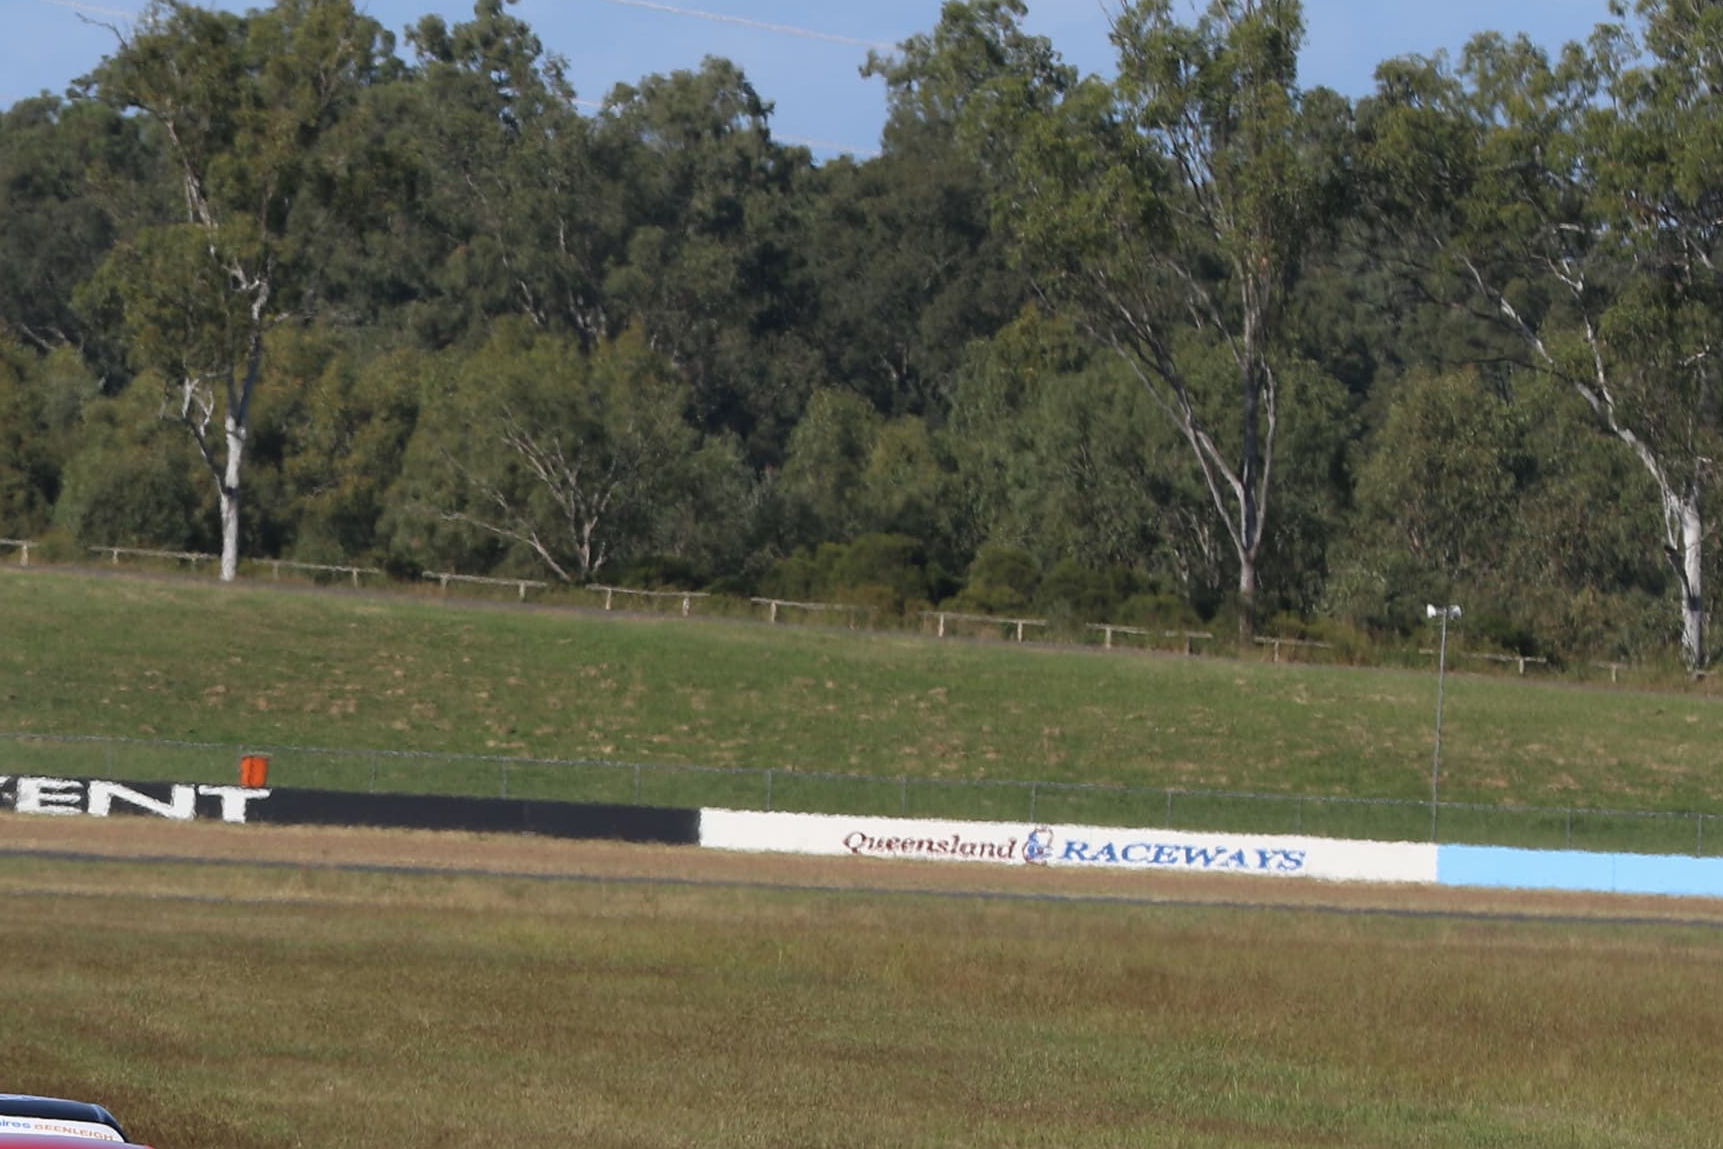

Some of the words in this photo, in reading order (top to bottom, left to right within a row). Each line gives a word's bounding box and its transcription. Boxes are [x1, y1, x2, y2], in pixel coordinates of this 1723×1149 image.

[842, 831, 1017, 860] Queensland
[1062, 840, 1307, 872] RACEWAYS
[34, 1123, 114, 1141] BEENLEIGH
